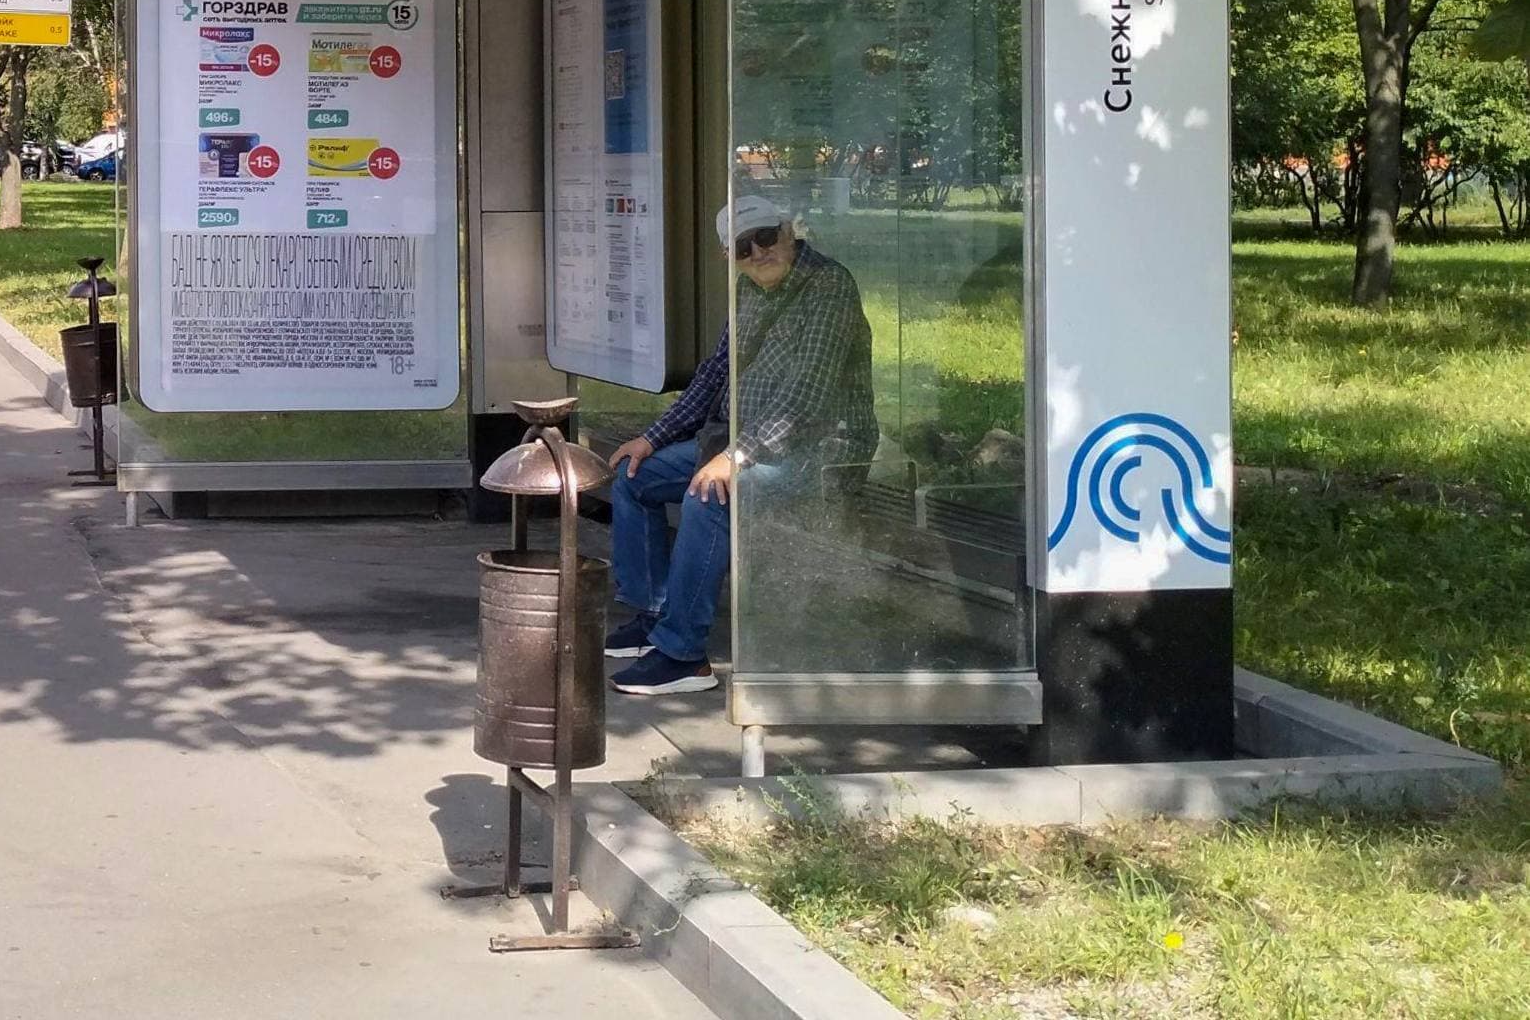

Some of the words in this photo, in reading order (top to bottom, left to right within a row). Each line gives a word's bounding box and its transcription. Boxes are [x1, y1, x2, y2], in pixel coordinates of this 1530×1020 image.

[202, 1, 289, 17] ГОРЗДРАВ
[392, 5, 411, 20] 15
[172, 235, 192, 291] БАД
[195, 234, 208, 288] НЕ
[210, 234, 261, 289] ЯВЛЯЕТСЯ
[262, 234, 352, 290] ЛЕКАРСТВЕННЫМ
[354, 235, 416, 292] СРЕДСТВОМ
[390, 356, 415, 374] 18+
